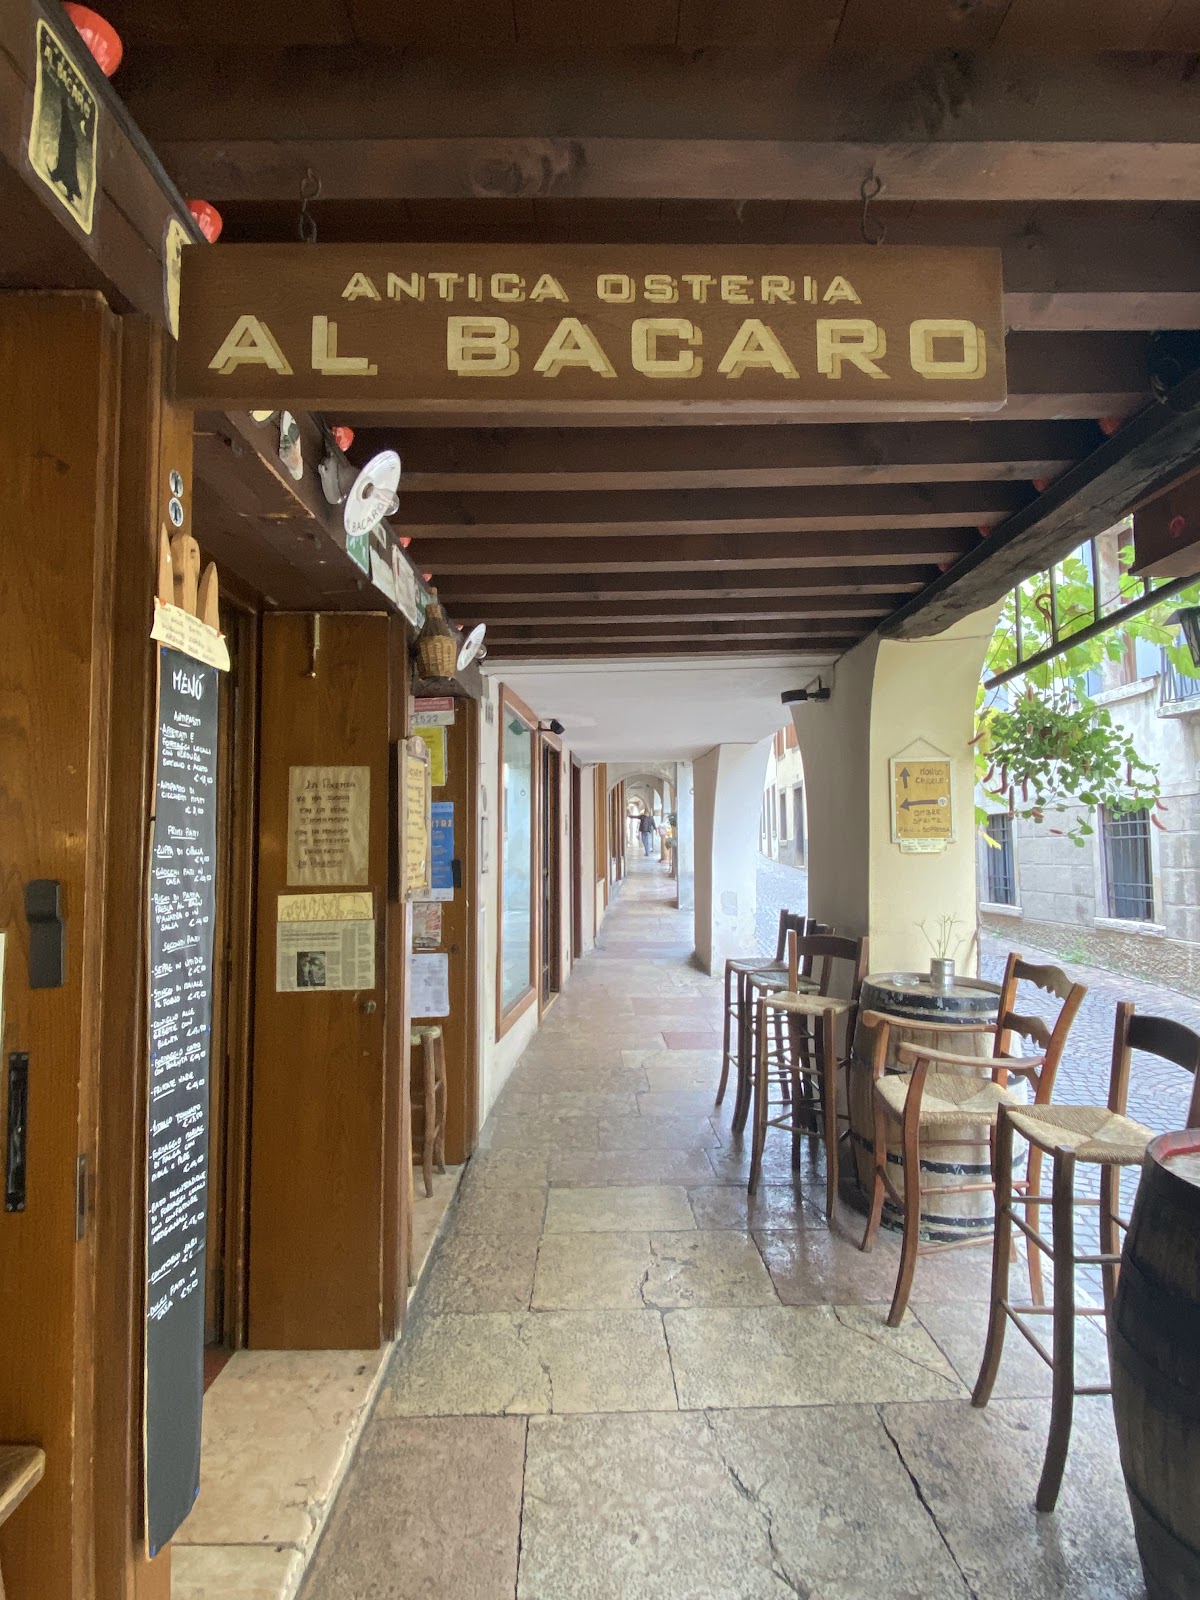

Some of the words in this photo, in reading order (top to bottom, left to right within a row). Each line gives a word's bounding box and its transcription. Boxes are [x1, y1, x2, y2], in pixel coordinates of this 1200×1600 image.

[341, 272, 569, 302] ANTICA
[596, 273, 862, 305] OSTERIA
[207, 315, 378, 375] AL
[446, 316, 987, 379] BACARO
[414, 714, 439, 725] 1522
